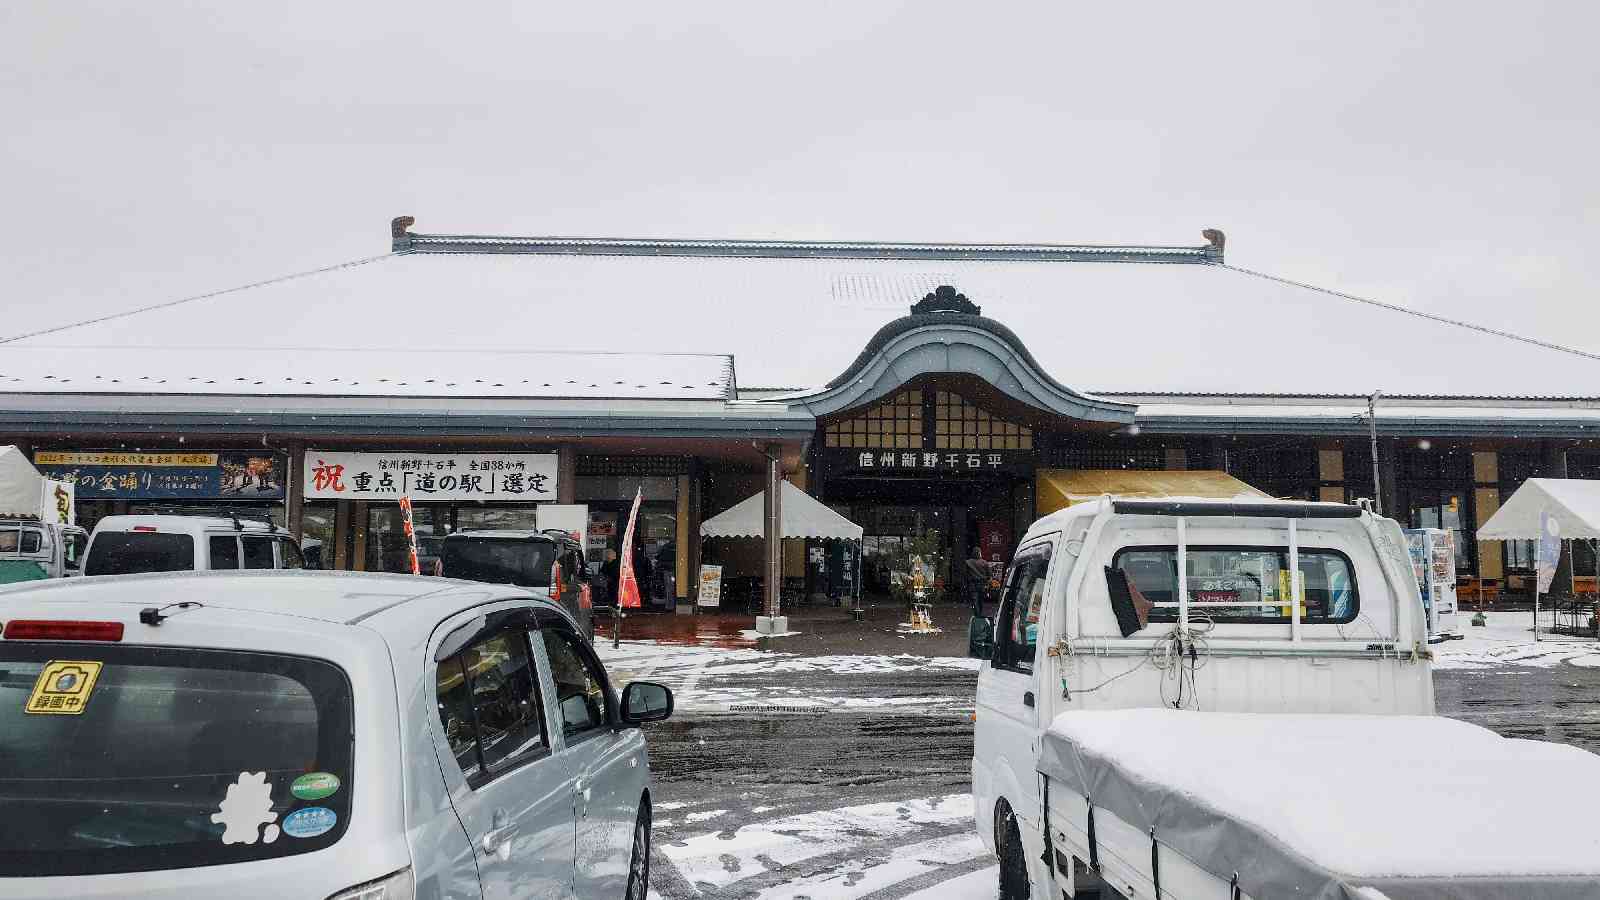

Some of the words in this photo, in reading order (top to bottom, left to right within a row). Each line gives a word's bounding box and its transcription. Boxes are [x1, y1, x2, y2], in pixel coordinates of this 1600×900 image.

[859, 453, 1003, 468] 信州新野千石平
[312, 460, 345, 492] 祝
[353, 472, 549, 493] 重点「道の駅」選定
